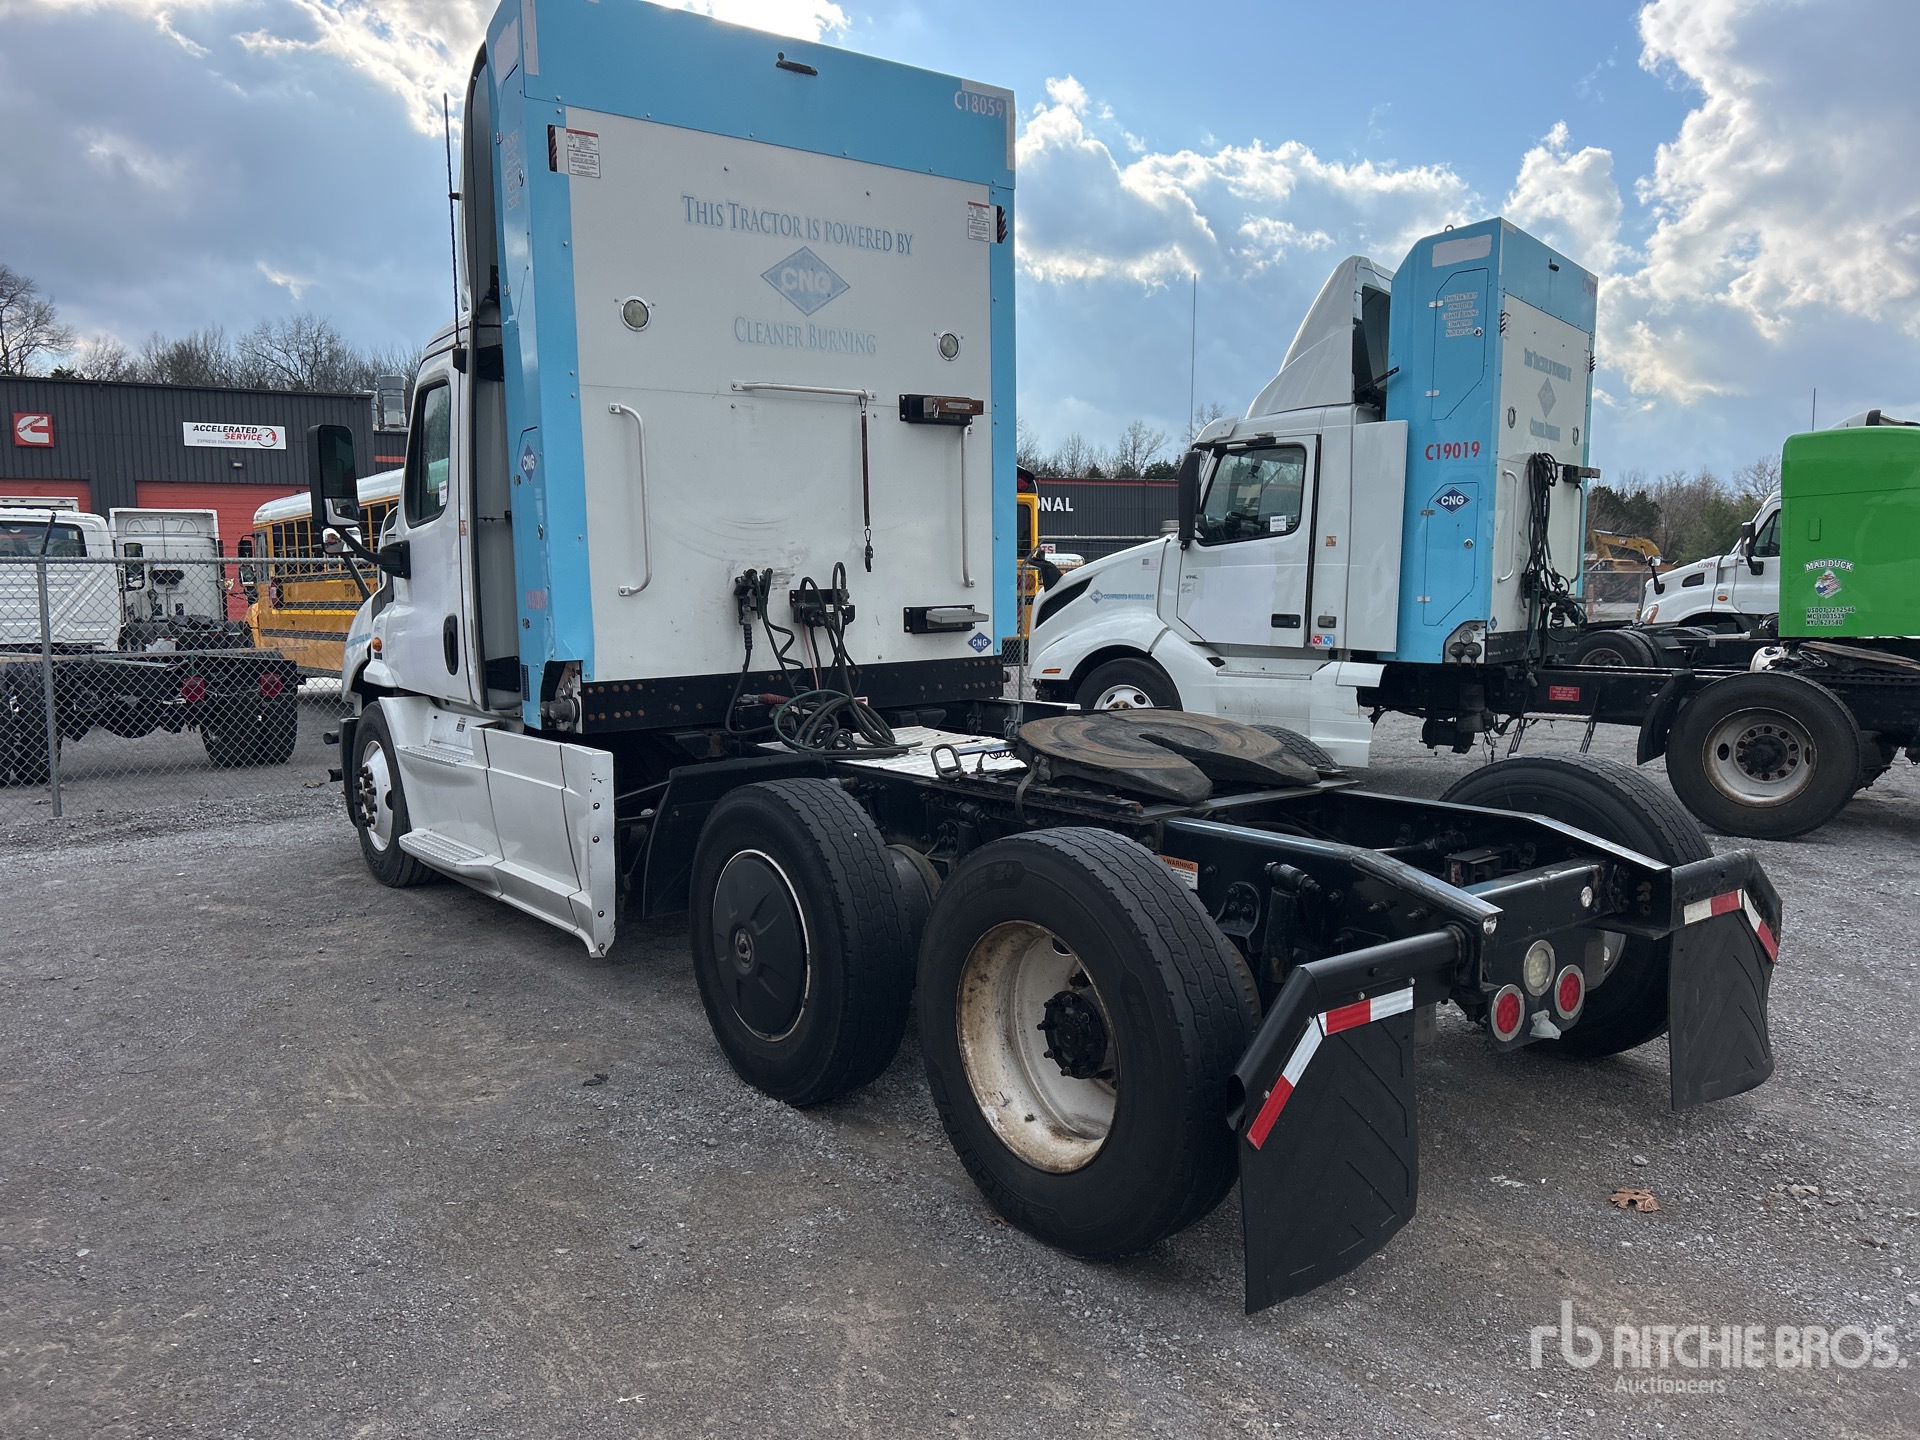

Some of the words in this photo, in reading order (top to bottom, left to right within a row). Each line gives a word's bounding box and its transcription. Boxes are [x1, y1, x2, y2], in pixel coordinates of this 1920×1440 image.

[954, 91, 1004, 118] C18059
[682, 195, 724, 227] THIS
[727, 202, 802, 238] TRACTOR
[806, 218, 820, 241] IS
[824, 221, 893, 252] POWERED
[896, 232, 913, 255] BY
[780, 266, 832, 294] CNG
[733, 316, 804, 349] CLEANER
[807, 323, 876, 356] BURNING
[193, 424, 258, 434] ACCELERATED
[224, 432, 262, 441] SERVICE
[1425, 441, 1480, 460] C19019
[522, 454, 535, 470] CNG
[1038, 497, 1074, 512] NAL
[1441, 495, 1465, 506] CNG
[1805, 560, 1826, 571] MAD
[1828, 560, 1853, 571] DUCK
[972, 638, 988, 647] CNG
[1167, 857, 1194, 870] WARNING
